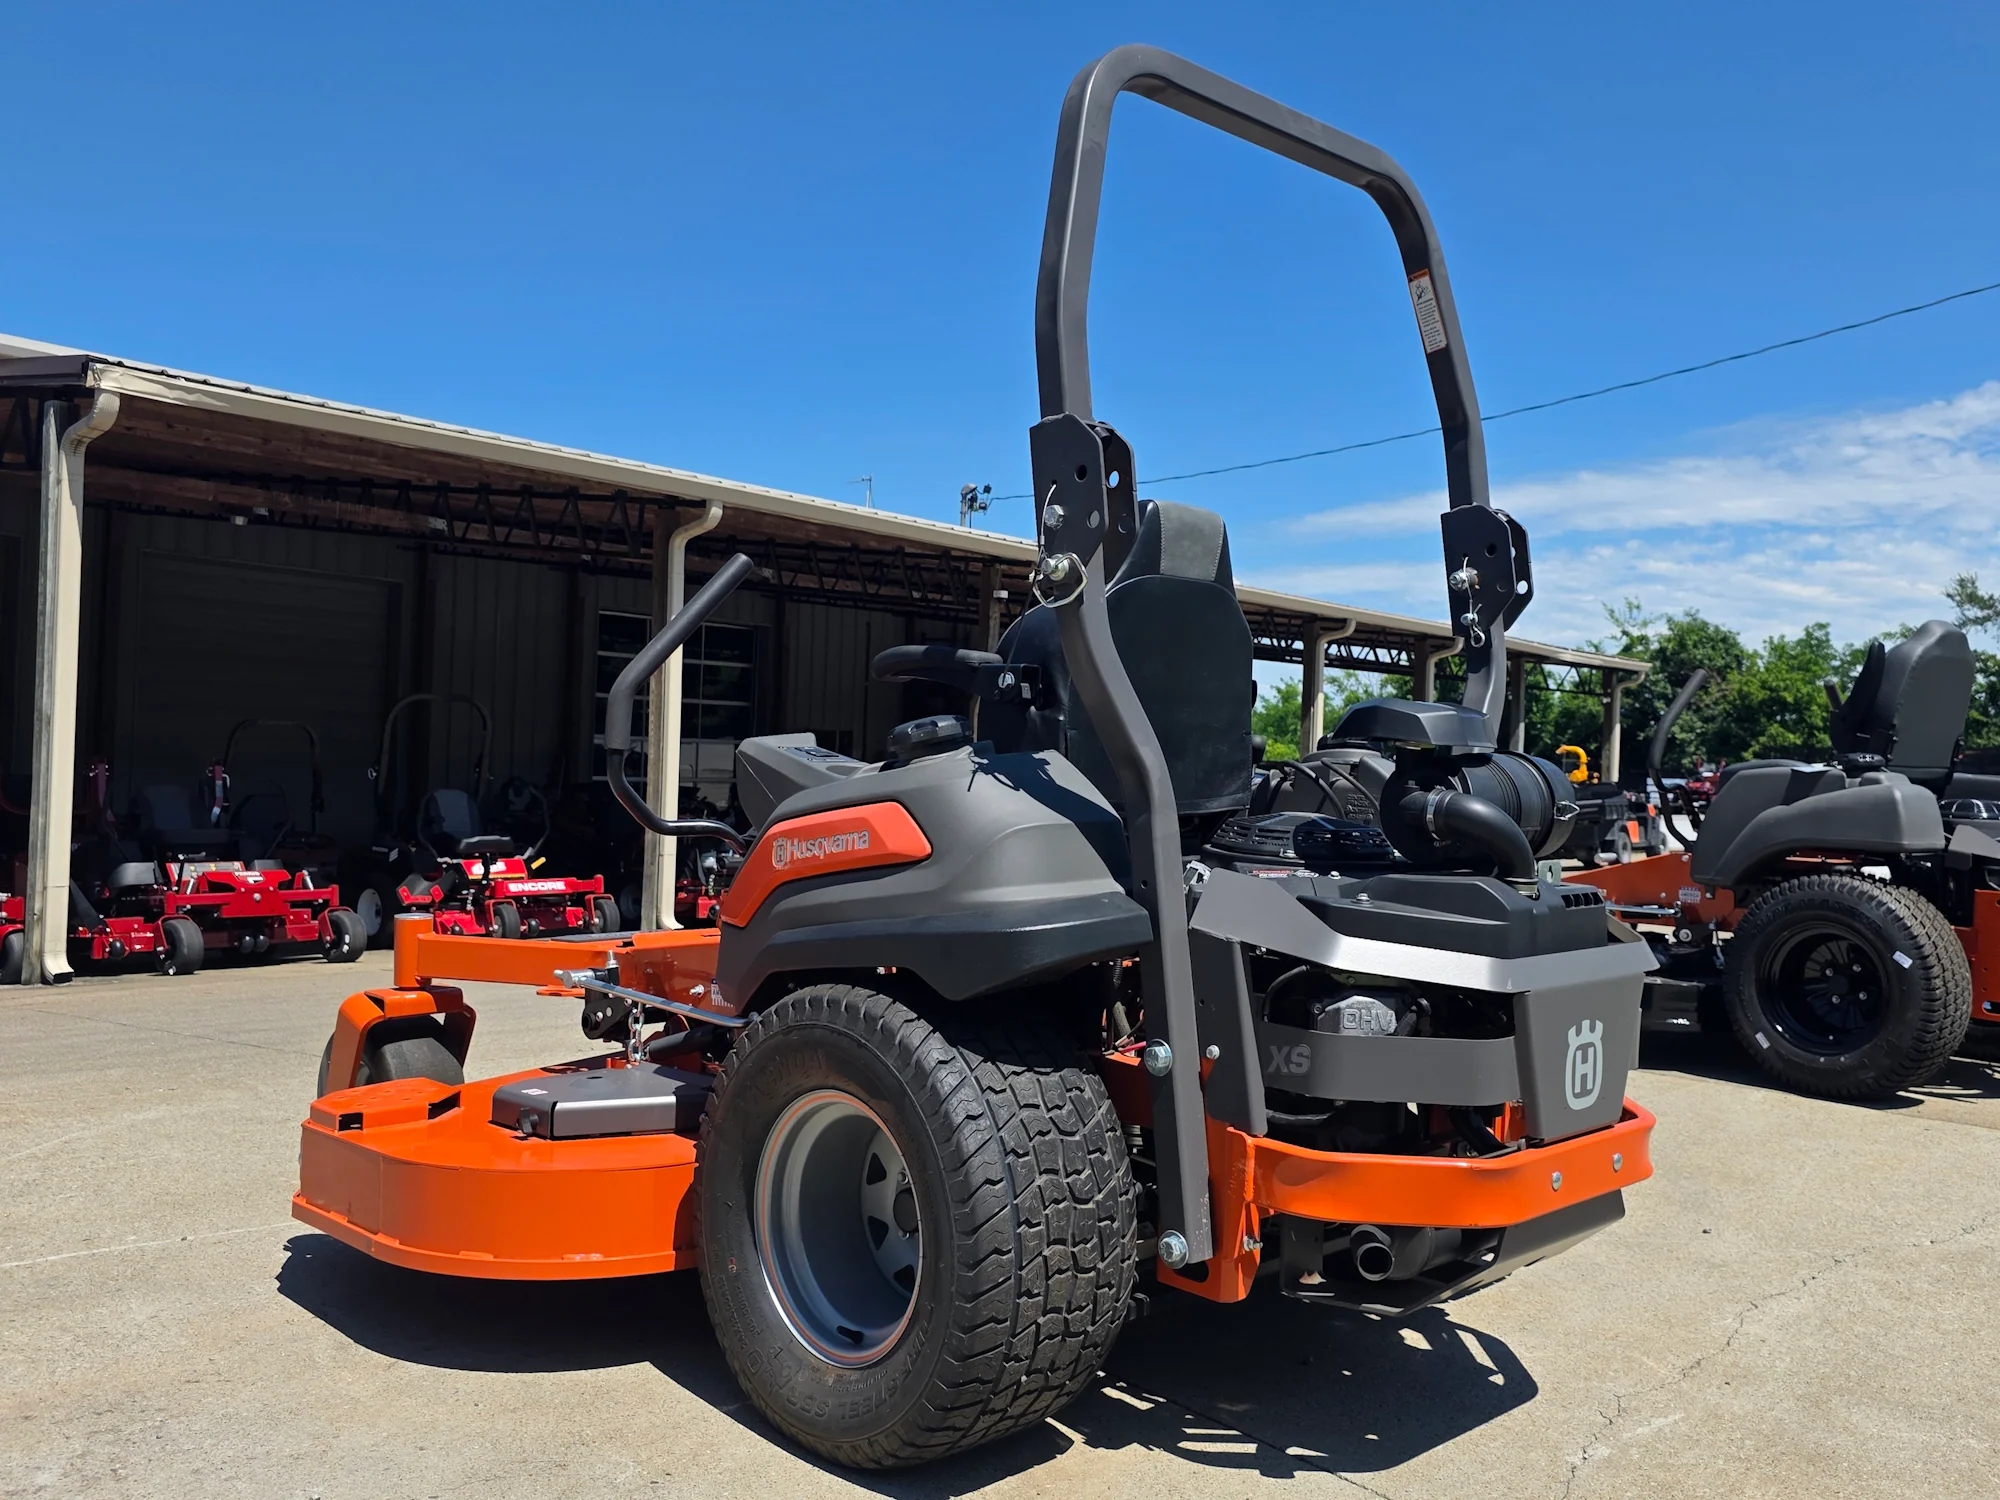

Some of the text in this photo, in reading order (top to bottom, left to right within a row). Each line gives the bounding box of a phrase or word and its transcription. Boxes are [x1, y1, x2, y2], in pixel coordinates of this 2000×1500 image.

[787, 829, 869, 862] Husqvarna
[507, 881, 567, 893] ENCORE
[1342, 1008, 1396, 1034] OHV
[1266, 1043, 1312, 1075] XS
